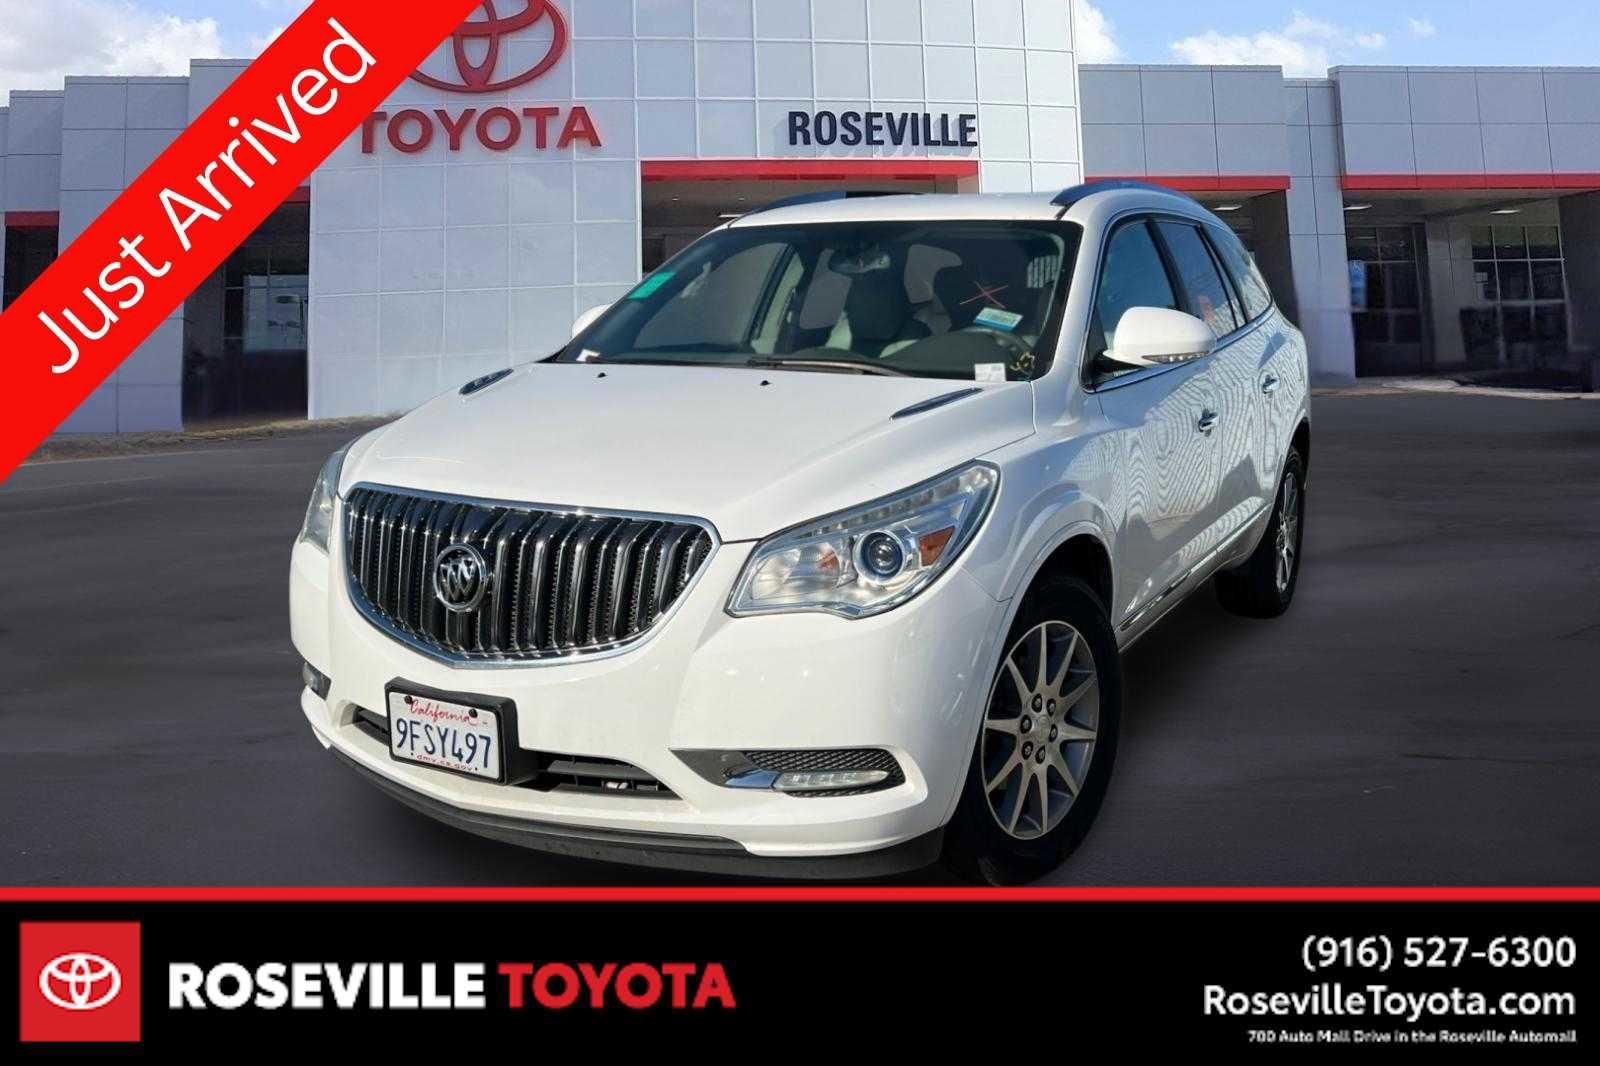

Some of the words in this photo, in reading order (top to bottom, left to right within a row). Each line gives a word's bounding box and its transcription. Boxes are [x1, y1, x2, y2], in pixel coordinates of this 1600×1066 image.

[361, 106, 602, 154] TOYOTA
[788, 110, 978, 147] ROSEVILLE
[409, 699, 477, 726] California
[396, 717, 492, 769] 9FSY497
